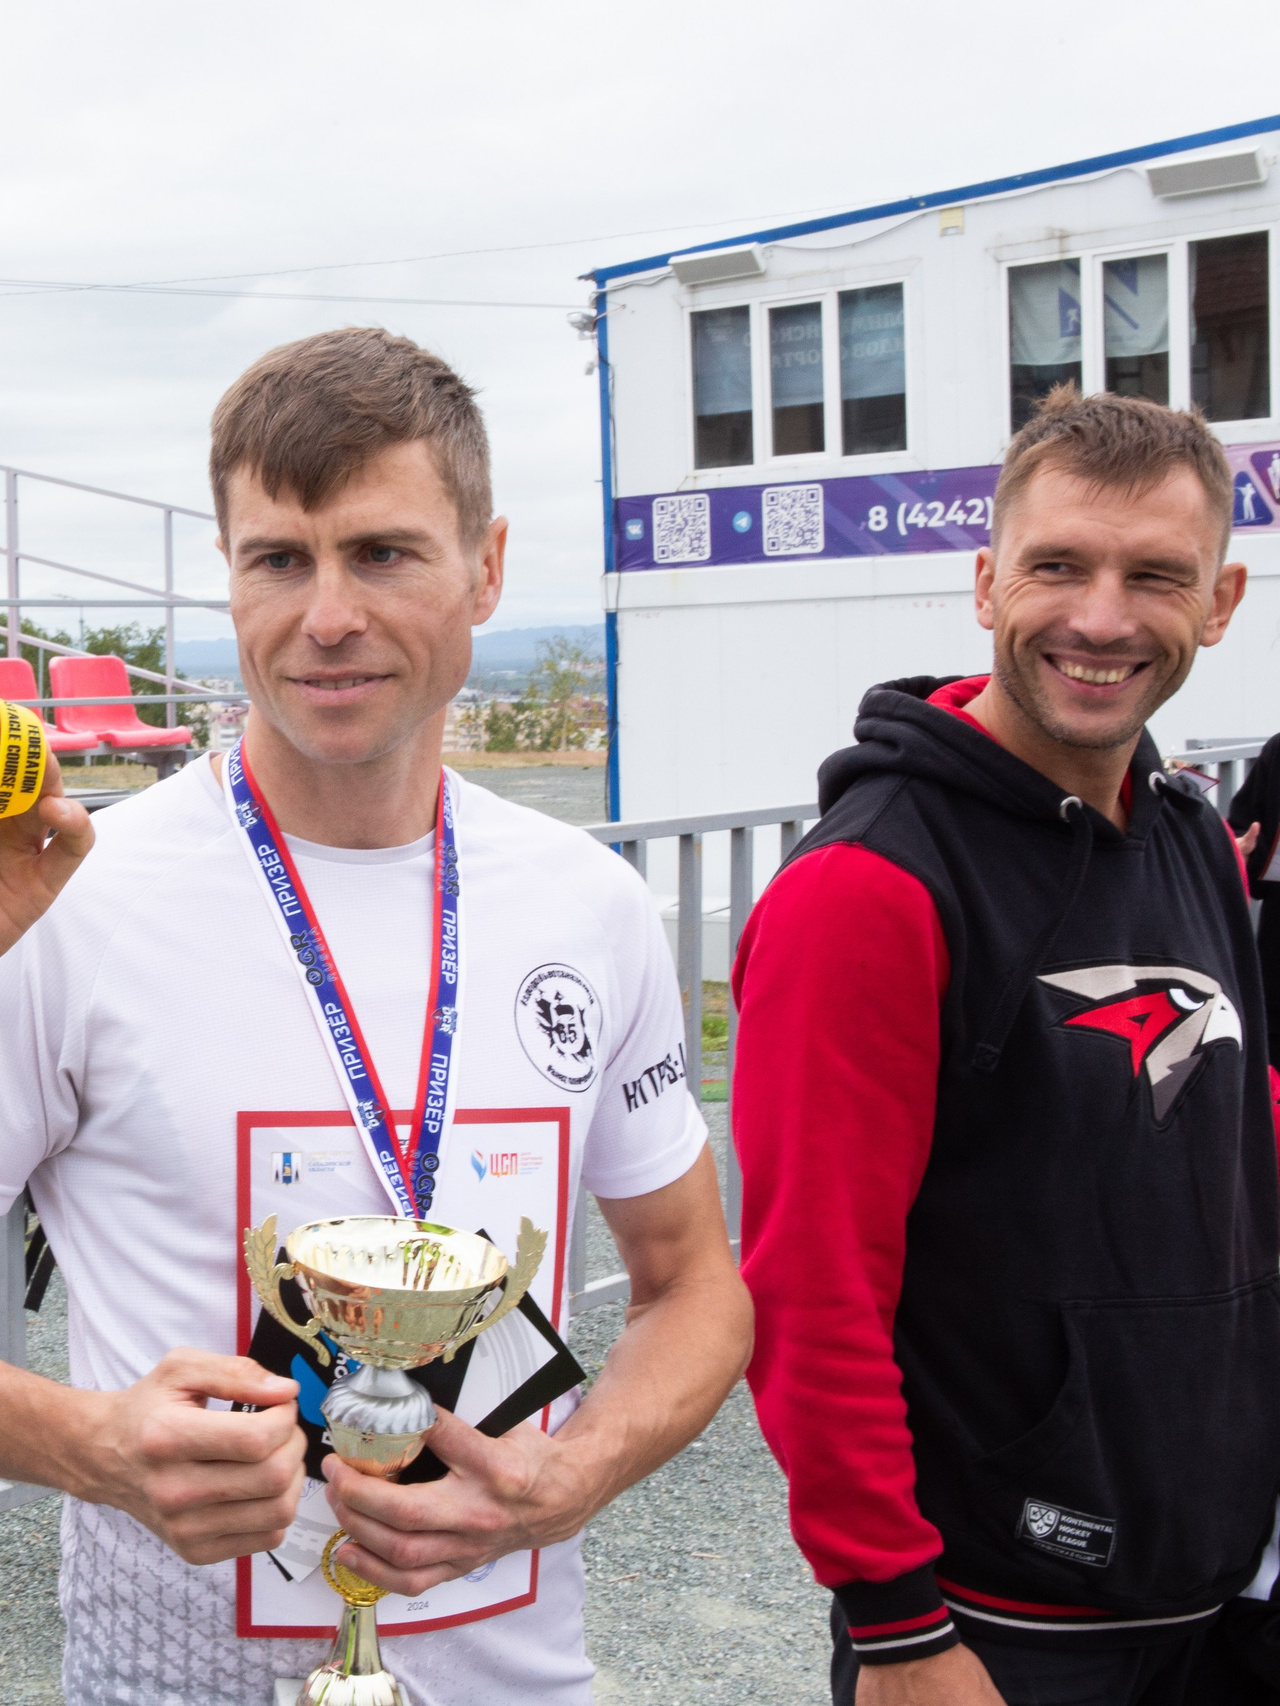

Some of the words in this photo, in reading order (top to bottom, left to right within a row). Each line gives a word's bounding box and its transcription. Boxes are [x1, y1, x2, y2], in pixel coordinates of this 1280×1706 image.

[868, 505, 888, 531] 8
[897, 496, 994, 535] (4242)
[0, 744, 21, 789] COURSE
[20, 724, 40, 793] FEDERATION
[258, 844, 302, 917] ПРИЗЁР
[442, 909, 459, 985] ПРИЗЁР
[324, 1002, 366, 1080] ПРИЗЁР
[558, 1023, 577, 1044] 65
[425, 1052, 449, 1134] ПРИЗЁР
[490, 1153, 518, 1177] ЦСП
[1057, 1535, 1087, 1548] LEAGUE
[1059, 1525, 1092, 1538] HOCKEY
[407, 1601, 429, 1611] 2024
